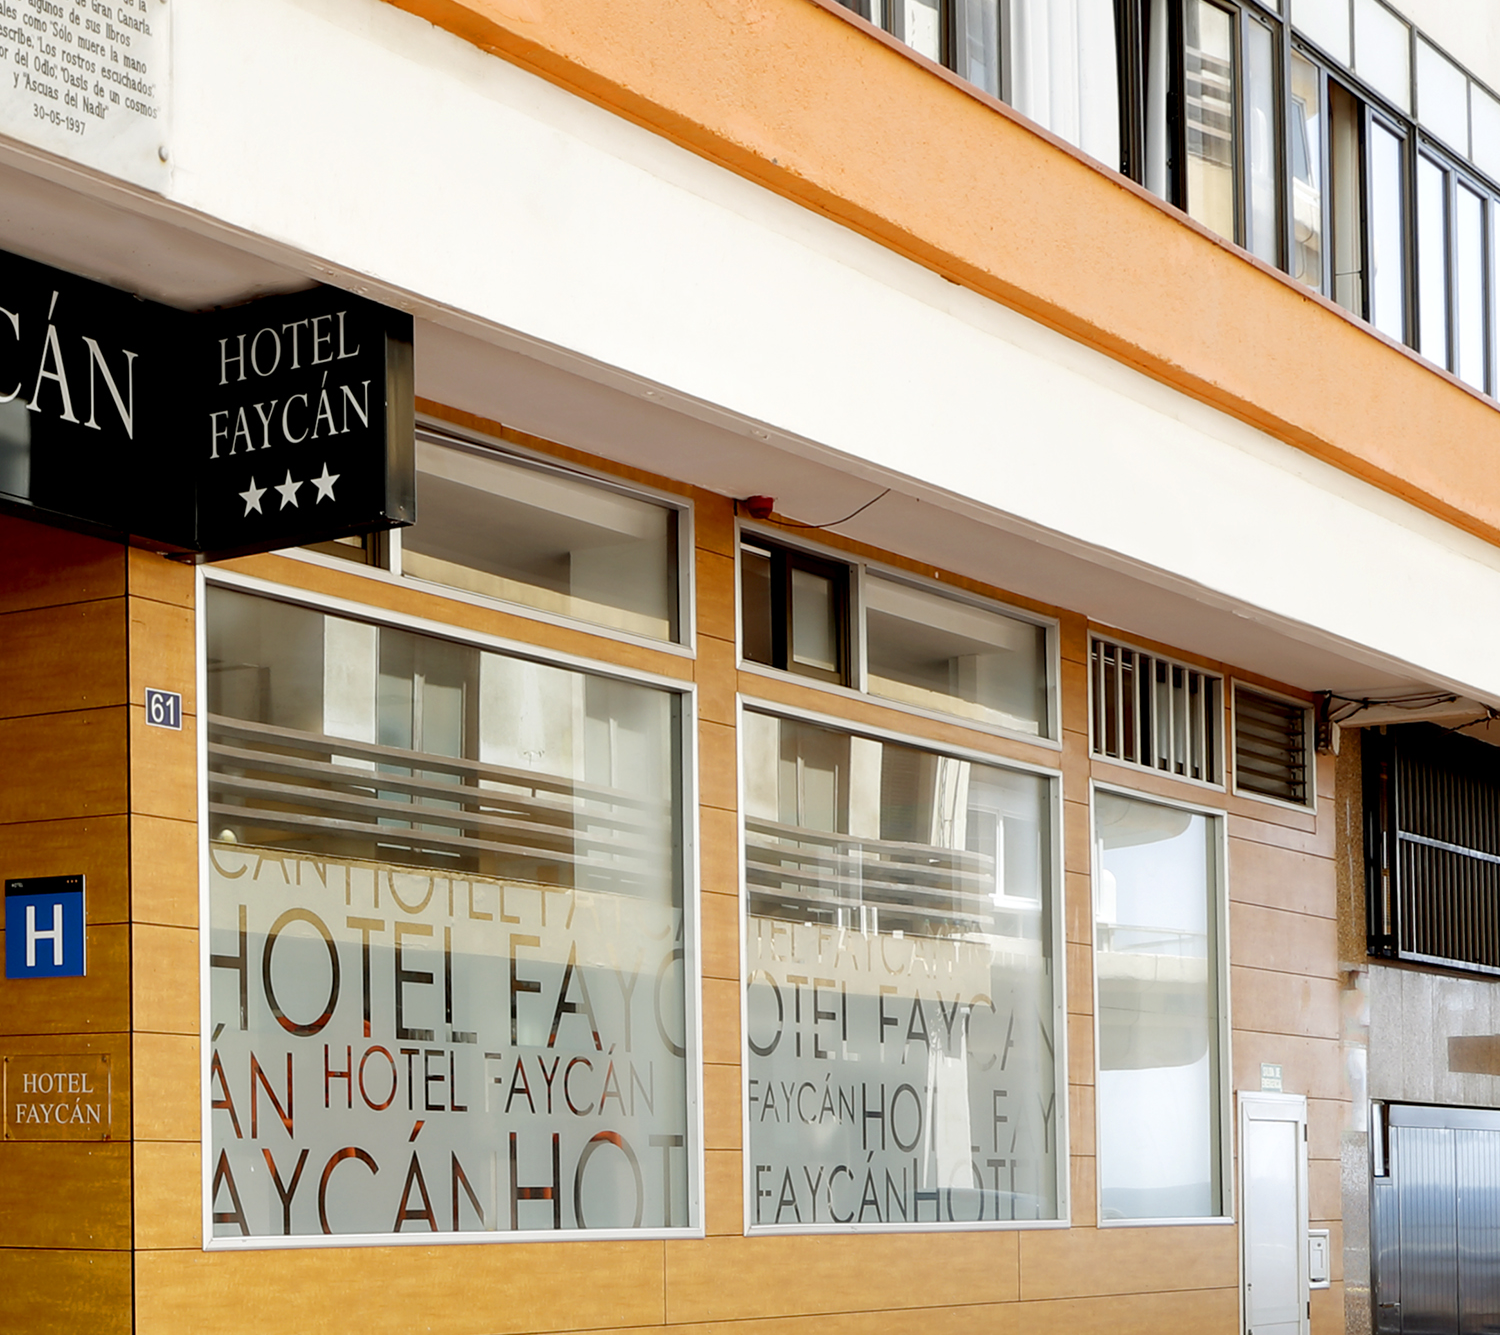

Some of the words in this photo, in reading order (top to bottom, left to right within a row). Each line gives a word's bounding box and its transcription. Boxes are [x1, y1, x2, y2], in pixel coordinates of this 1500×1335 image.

[21, 13, 49, 33] como
[76, 35, 107, 57] muere
[109, 45, 120, 64] la
[122, 54, 148, 74] mano
[68, 7, 82, 26] de
[84, 18, 102, 35] sus
[104, 22, 132, 47] libros
[13, 48, 30, 69] del
[92, 80, 106, 98] de
[108, 89, 121, 105] un
[60, 49, 97, 74] rostros
[12, 71, 21, 89] y
[63, 89, 79, 109] del
[32, 103, 87, 136] 30-05-1997
[217, 310, 361, 387] HOTEL
[209, 372, 372, 460] FAYCÁN
[150, 692, 175, 726] 61
[25, 903, 63, 967] H
[22, 1072, 95, 1094] HOTEL
[324, 1043, 469, 1113] HOTEL
[484, 1042, 655, 1118] FAYCÁN
[15, 1098, 102, 1125] FAYCÁN
